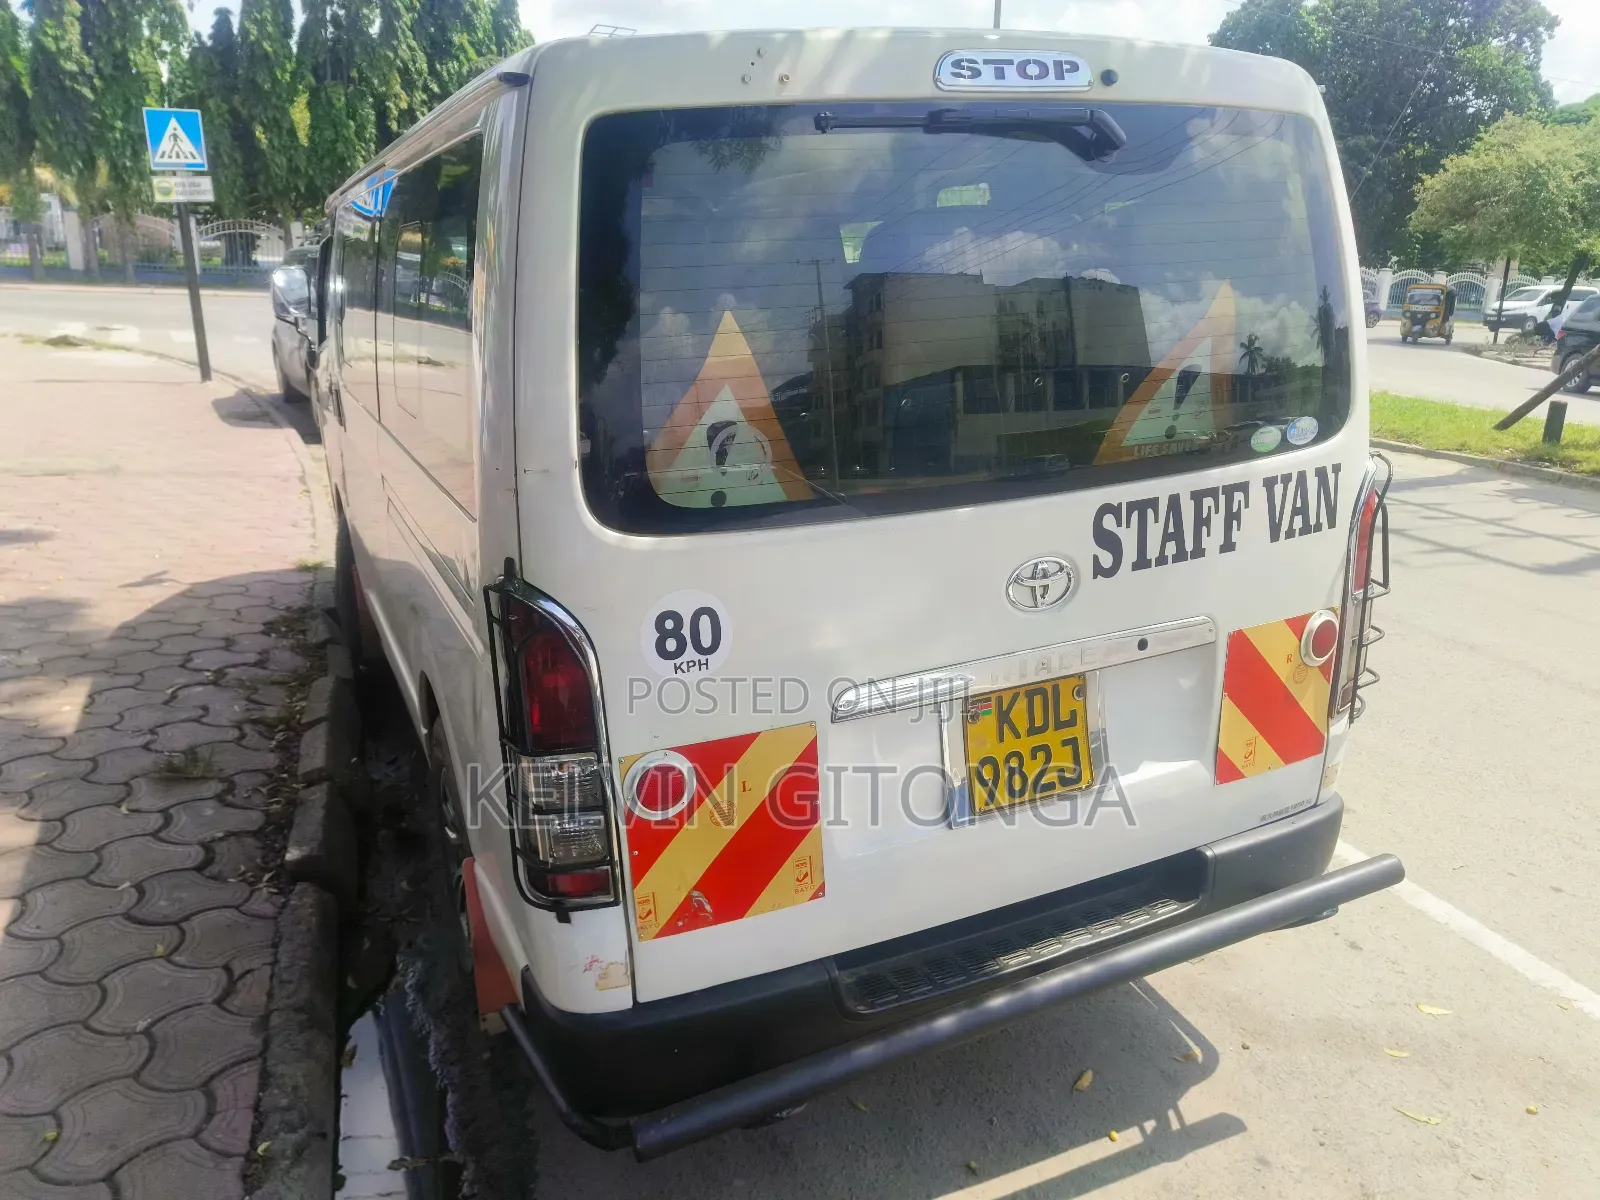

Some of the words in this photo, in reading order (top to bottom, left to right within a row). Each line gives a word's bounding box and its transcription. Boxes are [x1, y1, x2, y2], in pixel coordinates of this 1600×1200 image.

[950, 57, 1080, 81] STOP
[1092, 480, 1250, 580] STAFF
[1262, 462, 1342, 543] VAN
[654, 606, 722, 661] 80
[673, 657, 710, 675] KPH
[1286, 653, 1293, 664] R
[995, 683, 1078, 744] KDL
[976, 736, 1083, 807] 982J
[741, 780, 751, 792] L
[794, 884, 815, 895] BAYO
